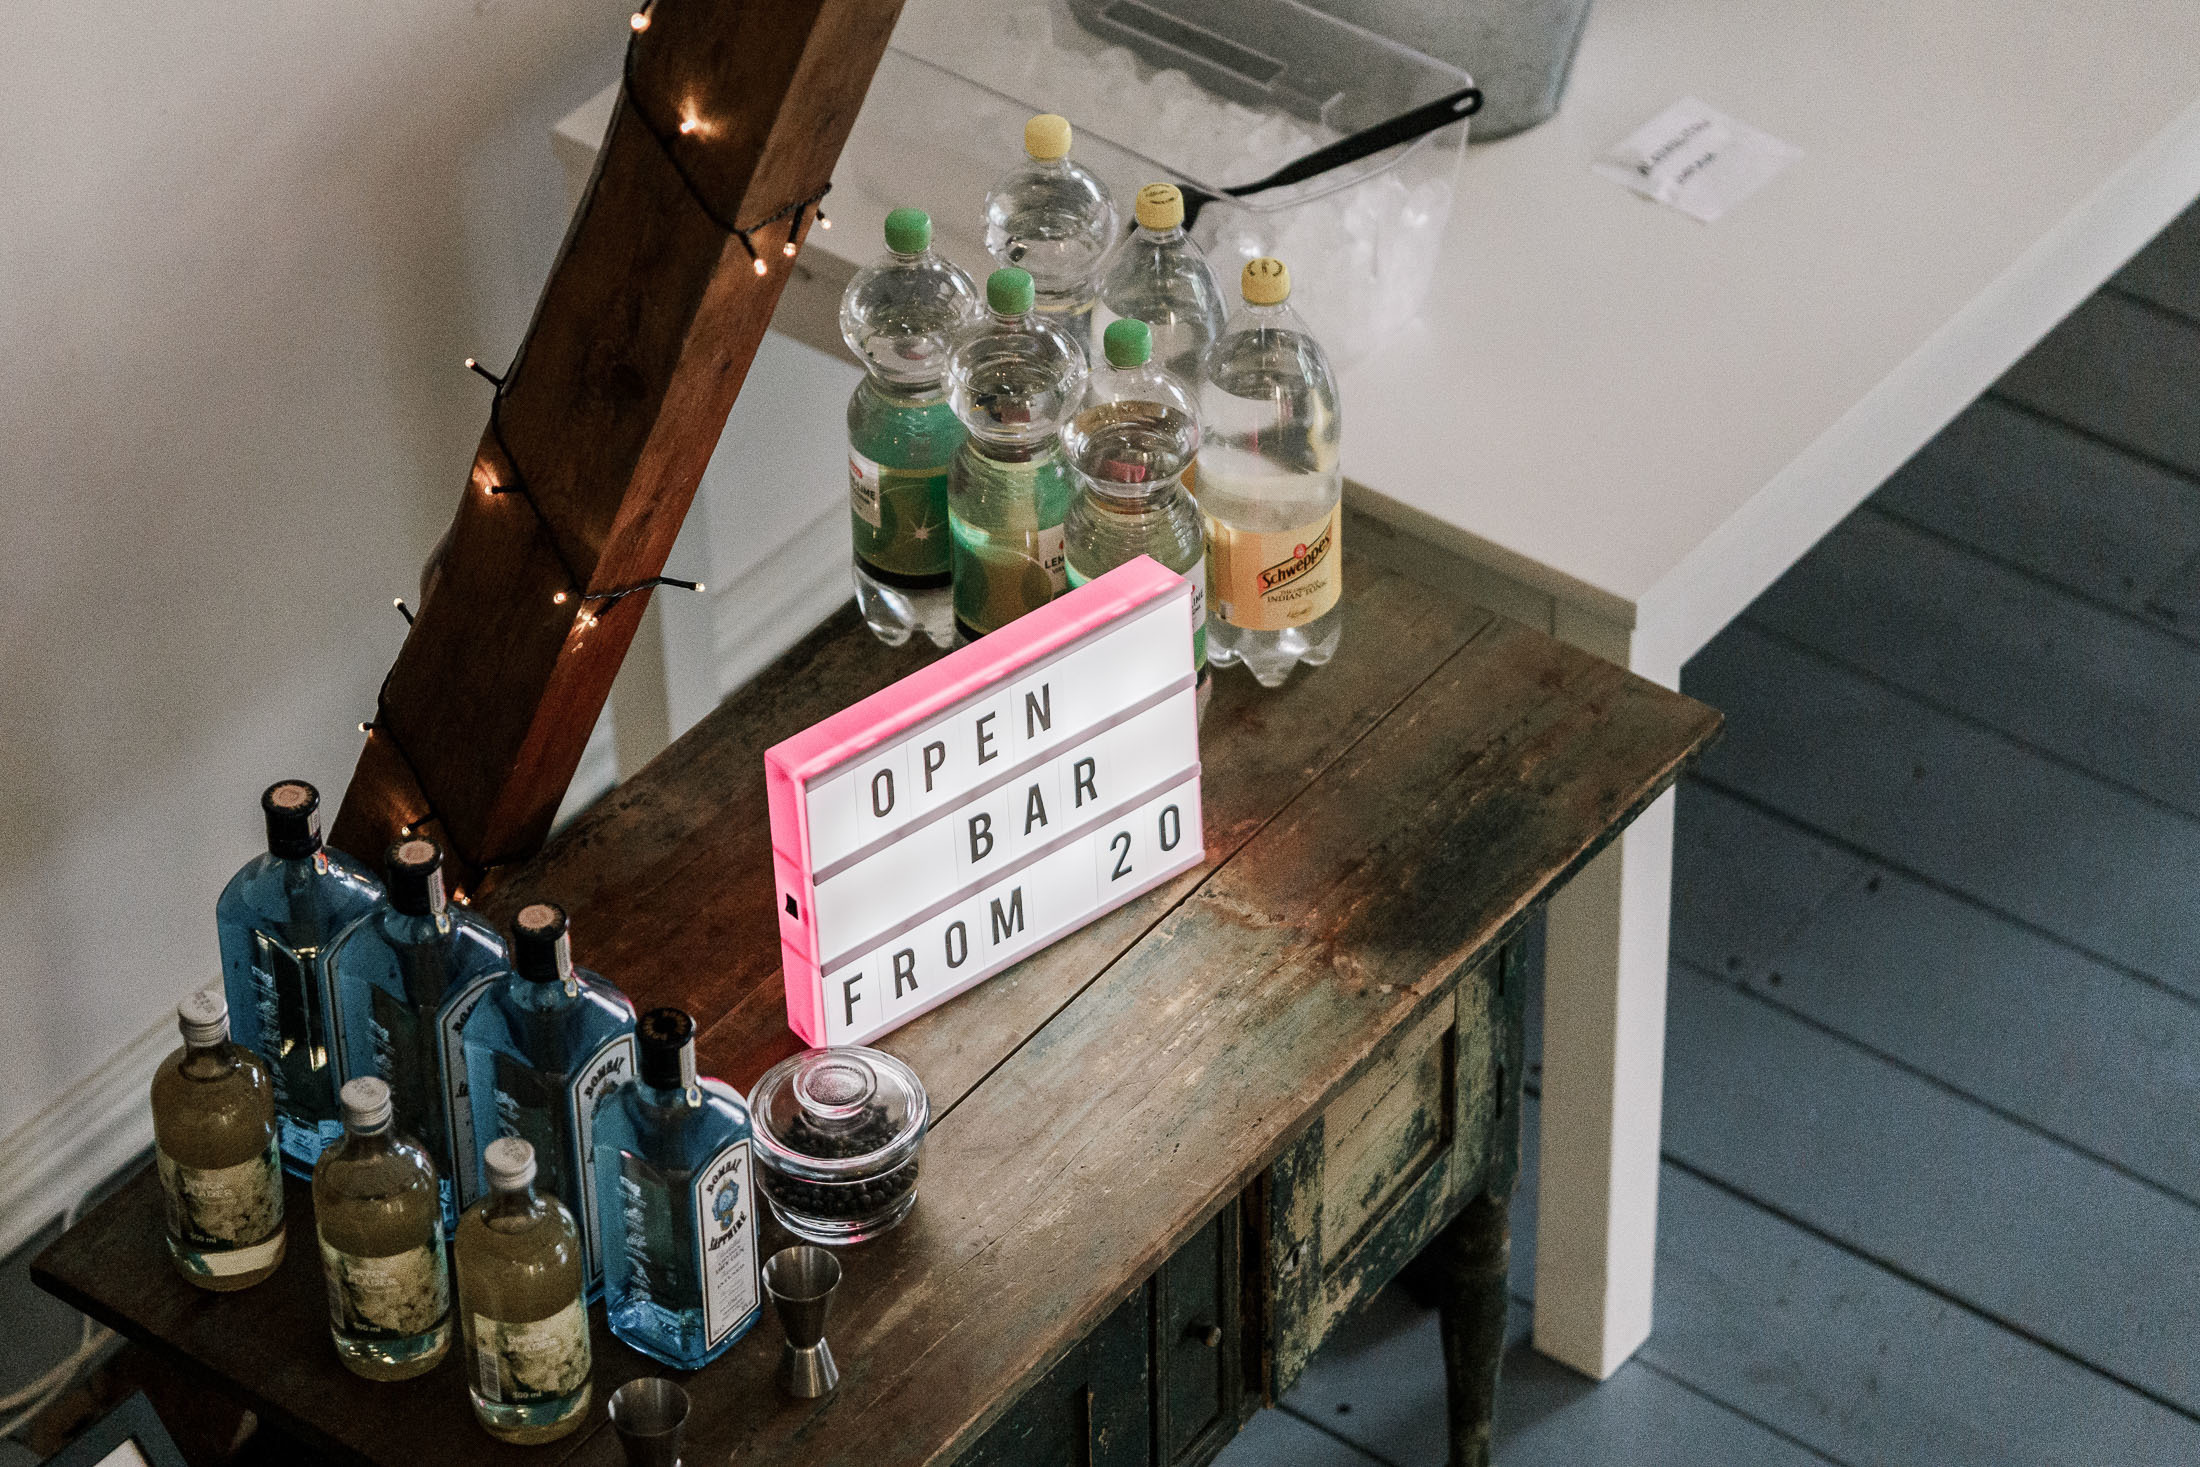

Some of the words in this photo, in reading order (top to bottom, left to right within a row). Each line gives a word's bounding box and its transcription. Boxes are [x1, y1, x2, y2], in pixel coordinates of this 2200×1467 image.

[1262, 536, 1330, 589] Schweppes
[871, 682, 1052, 818] OPEN
[968, 756, 1099, 864] BAR
[843, 885, 1026, 1027] FROM
[1109, 803, 1181, 881] 20
[706, 1158, 742, 1195] BOMBAY
[708, 1211, 747, 1252] SAPPHIRE
